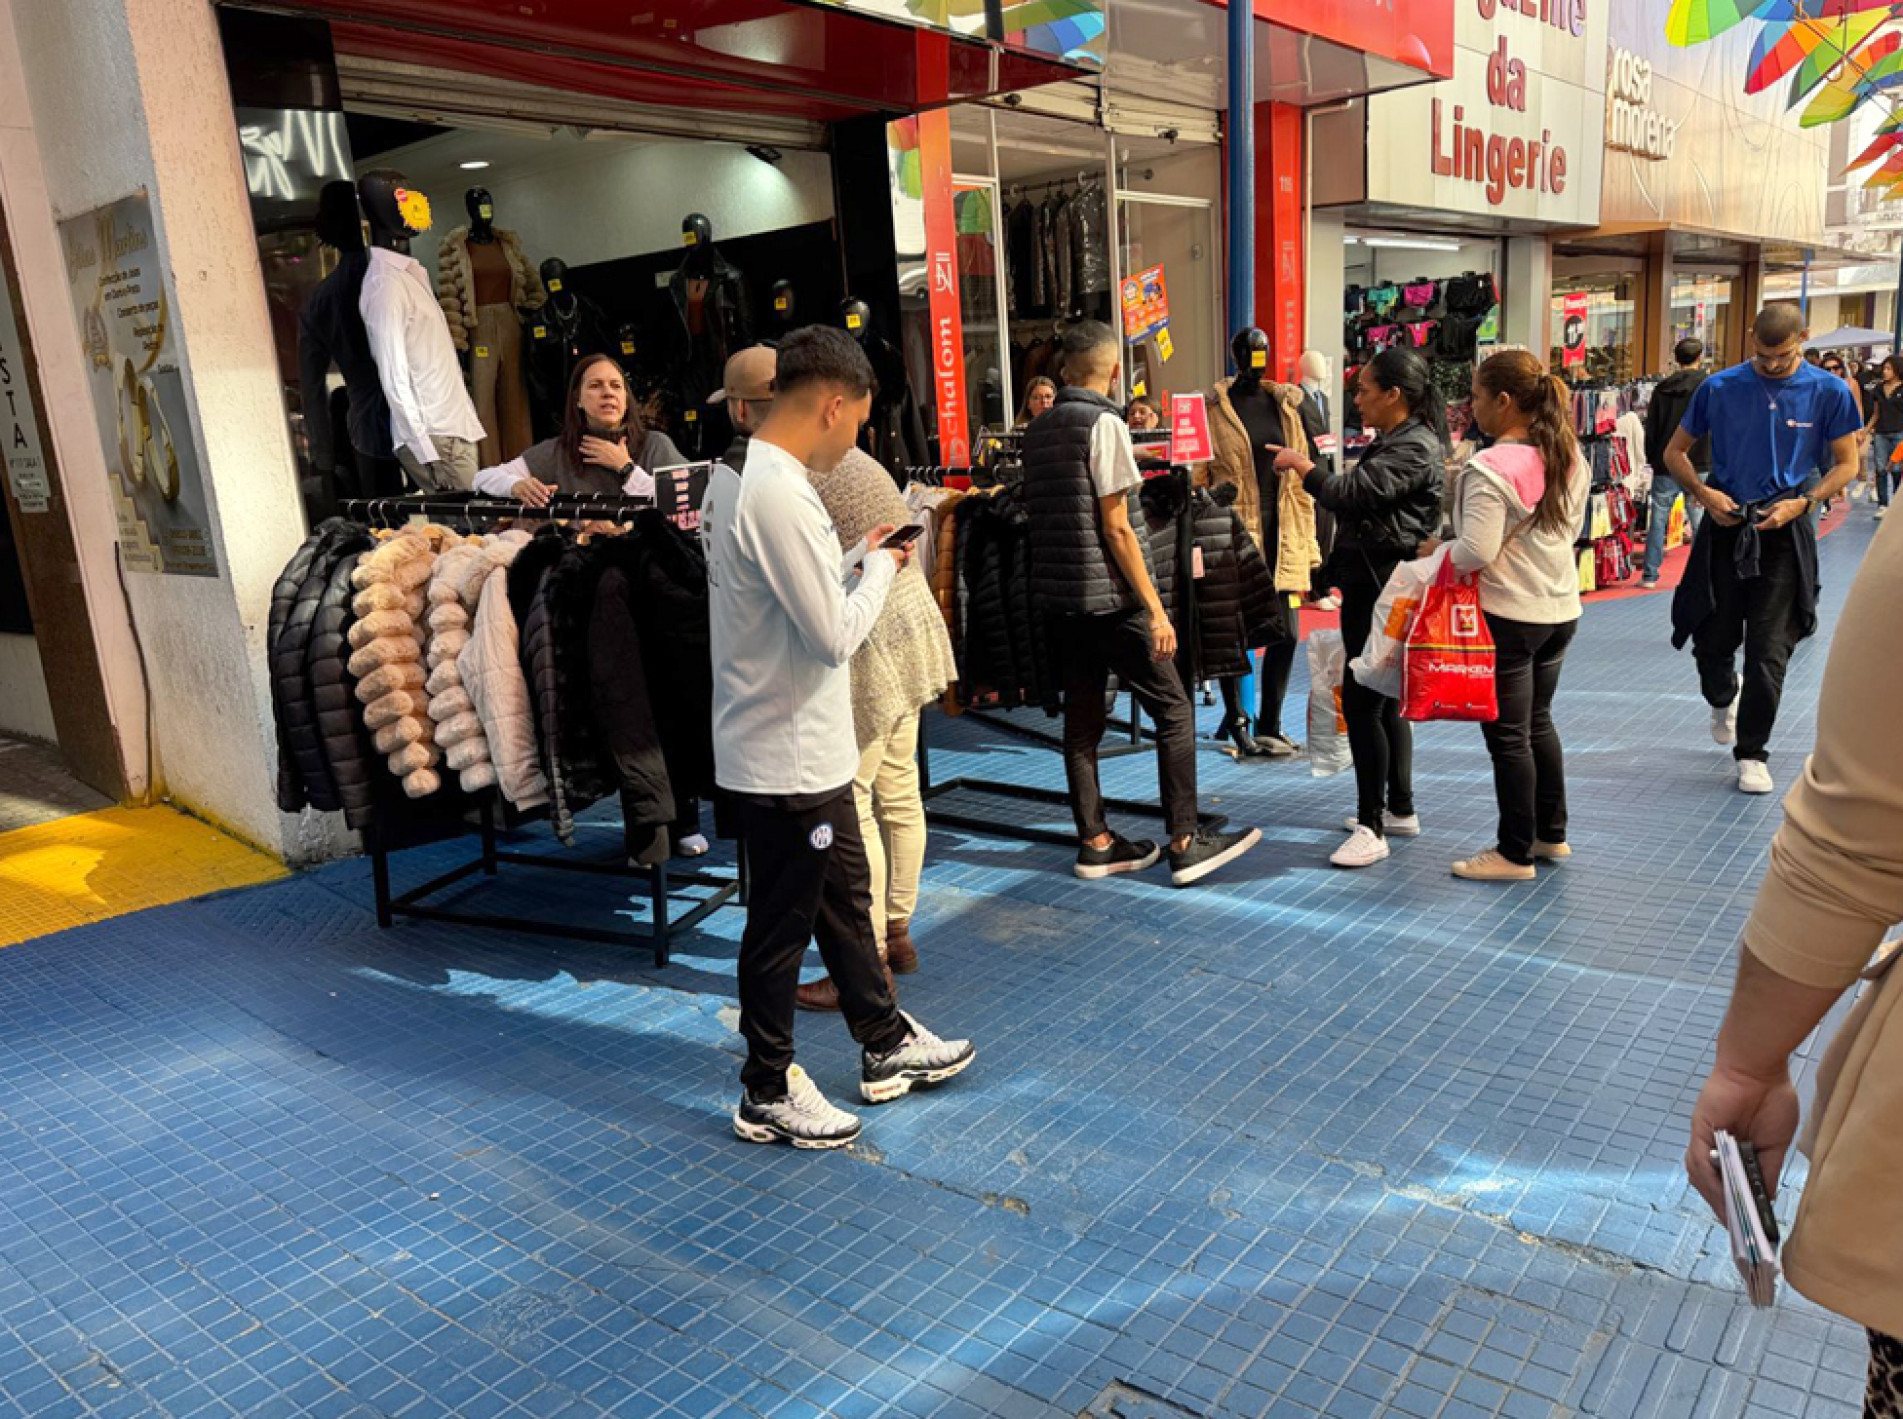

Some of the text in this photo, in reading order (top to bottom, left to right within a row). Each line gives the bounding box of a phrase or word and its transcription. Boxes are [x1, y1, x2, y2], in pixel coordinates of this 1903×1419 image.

[1487, 35, 1526, 113] da
[1613, 47, 1651, 104] rosa
[1431, 97, 1567, 205] Lingerie
[1611, 98, 1676, 161] morena
